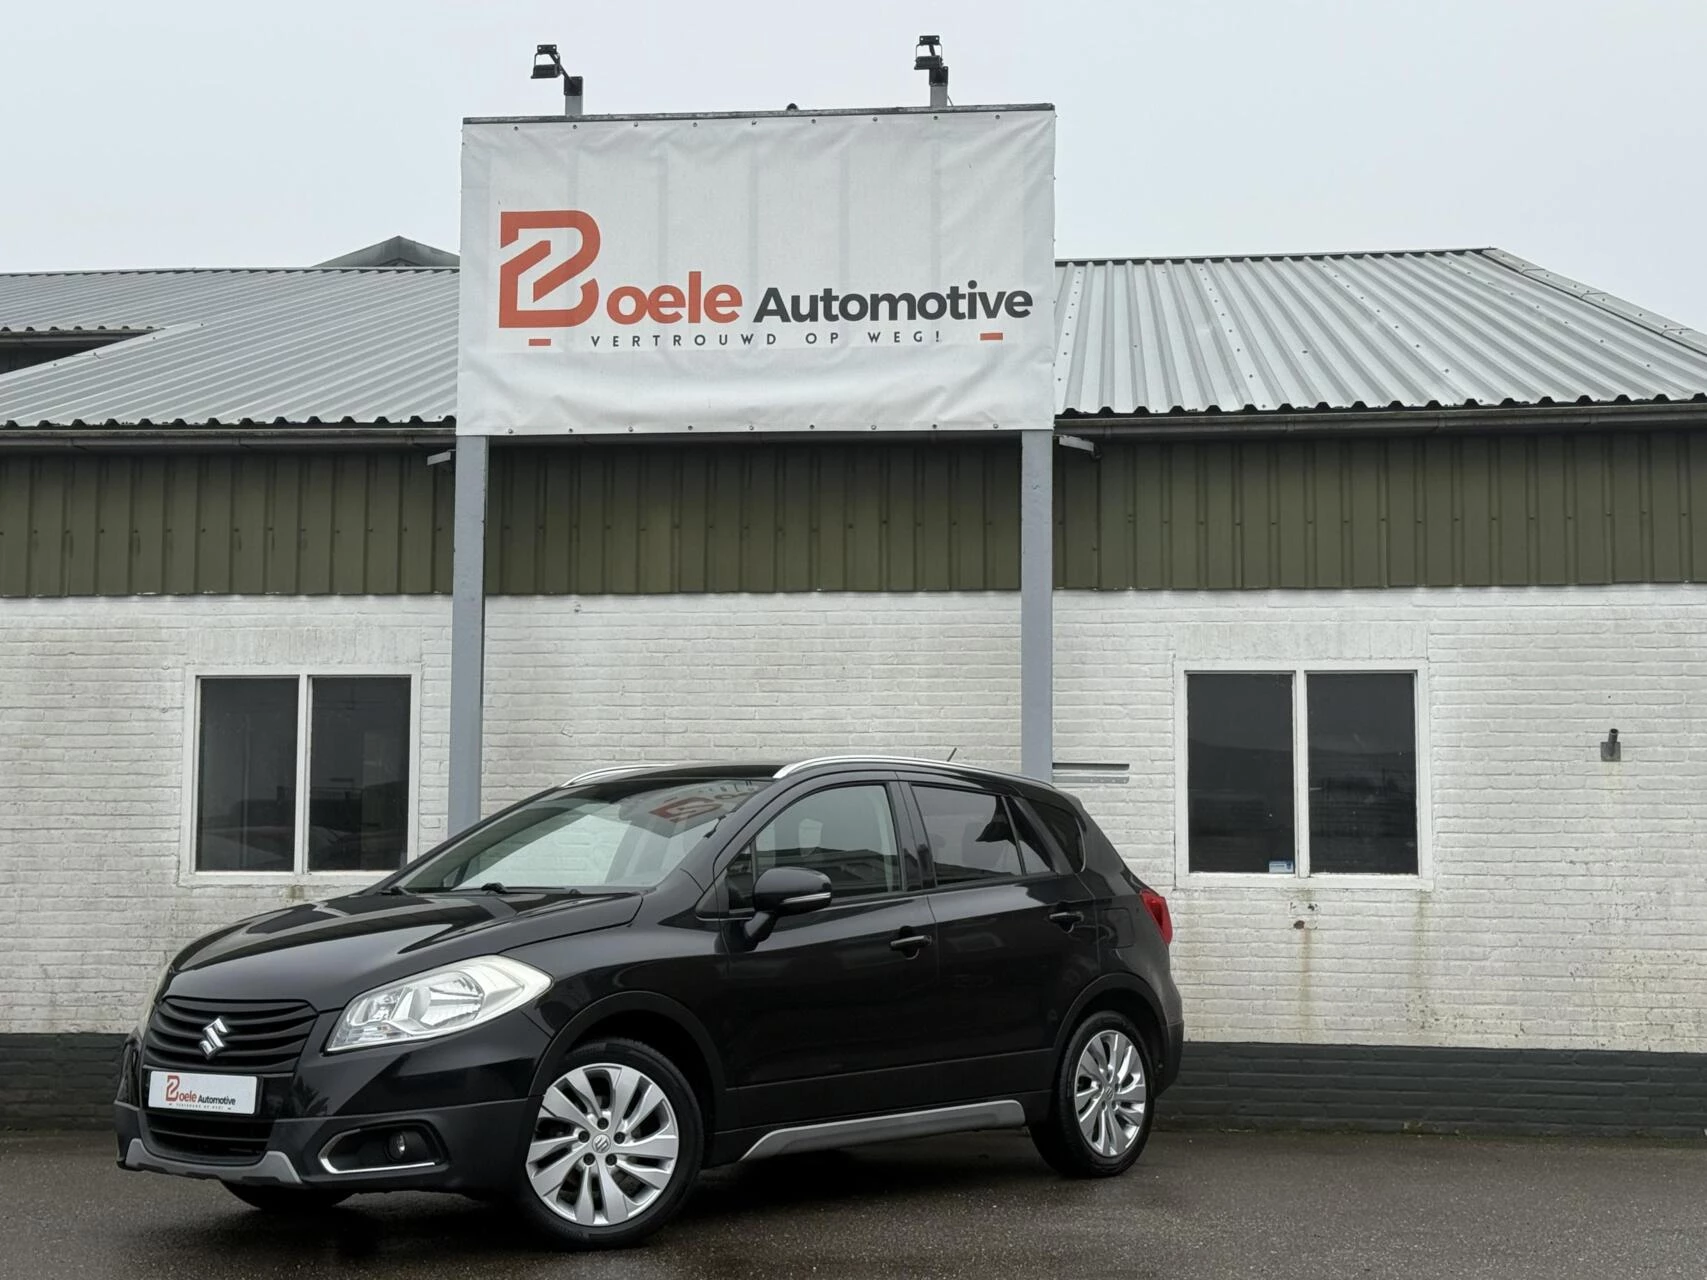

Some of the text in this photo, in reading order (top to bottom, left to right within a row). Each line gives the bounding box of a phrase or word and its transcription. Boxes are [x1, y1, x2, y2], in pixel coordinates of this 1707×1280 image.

[499, 210, 1033, 328] Boele Automotive
[591, 331, 941, 347] VERTROUWD OP WEG!
[198, 1094, 236, 1105] Automotive
